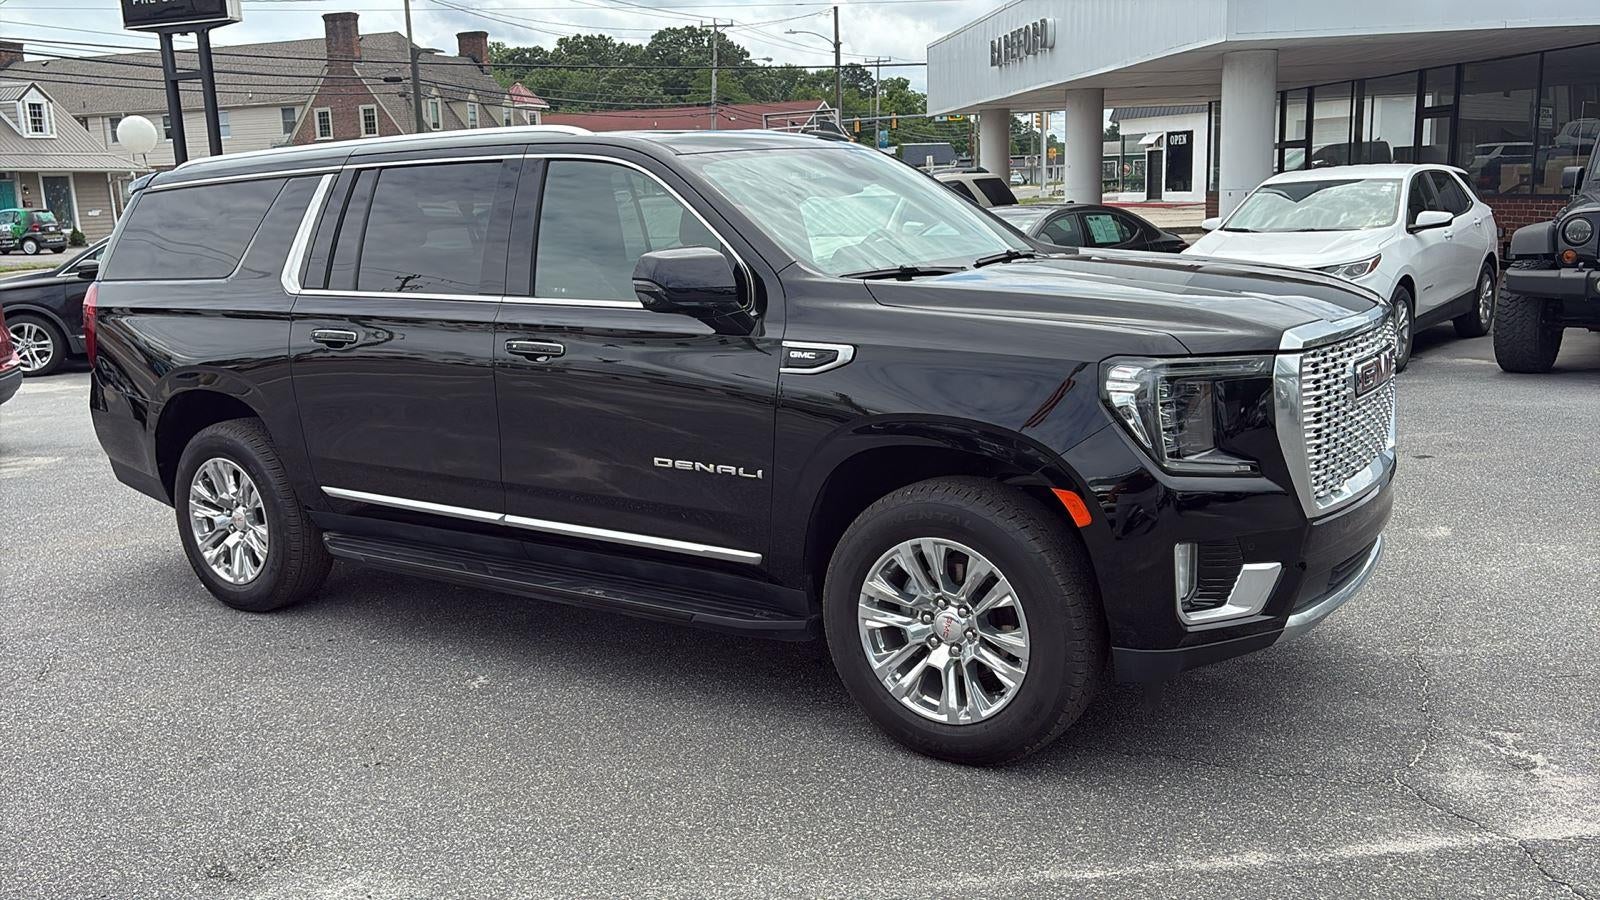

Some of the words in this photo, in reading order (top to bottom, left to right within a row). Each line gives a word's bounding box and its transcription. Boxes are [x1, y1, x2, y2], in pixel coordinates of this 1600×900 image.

[990, 17, 1055, 67] BAREFORD
[1170, 134, 1187, 145] OPEN
[790, 351, 816, 359] GMC
[653, 457, 763, 479] DENALI
